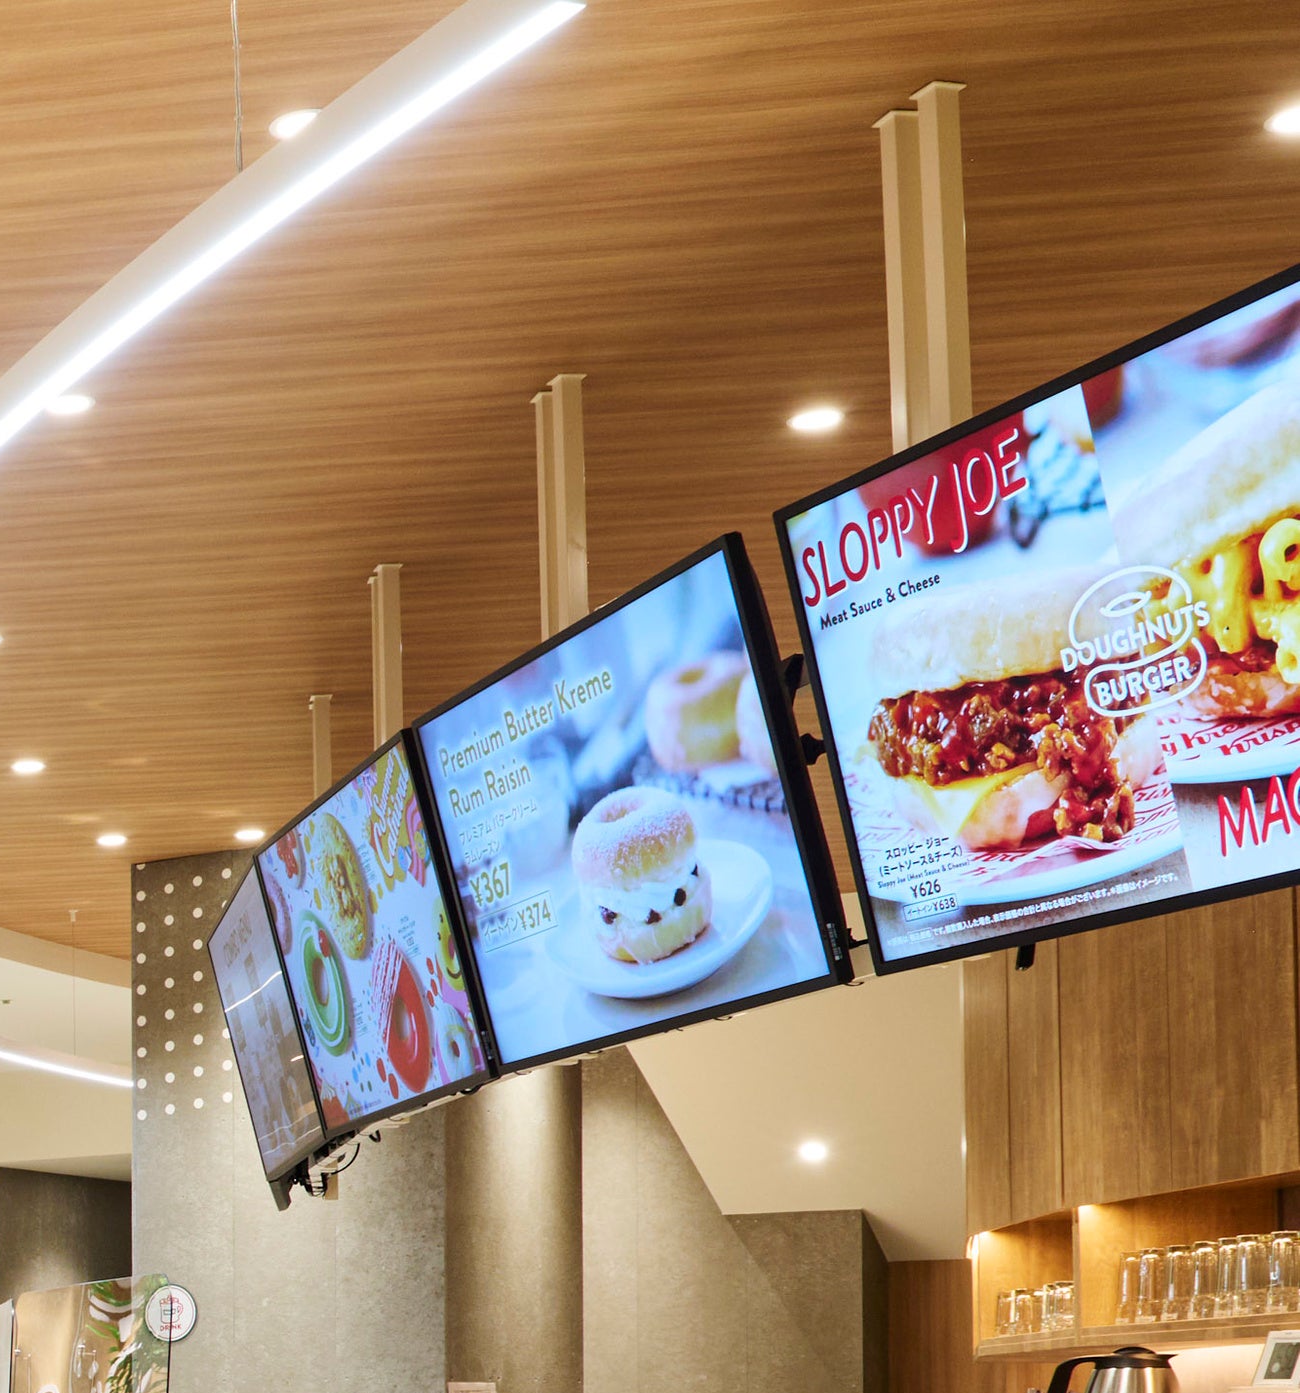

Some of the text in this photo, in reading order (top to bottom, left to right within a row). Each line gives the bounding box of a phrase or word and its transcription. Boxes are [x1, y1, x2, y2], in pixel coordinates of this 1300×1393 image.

[801, 427, 1028, 608] SLOPPY JOE
[819, 571, 941, 630] Meat Sauce & Cheese
[1059, 600, 1210, 674] DOUGHNUTS
[1094, 656, 1193, 706] BURGER
[439, 670, 612, 778] Premium Butter Kreme
[448, 759, 532, 818] Rum Raisin
[886, 836, 950, 861] スロッピー ジョー
[470, 862, 510, 907] ¥367
[910, 879, 941, 898] ¥626
